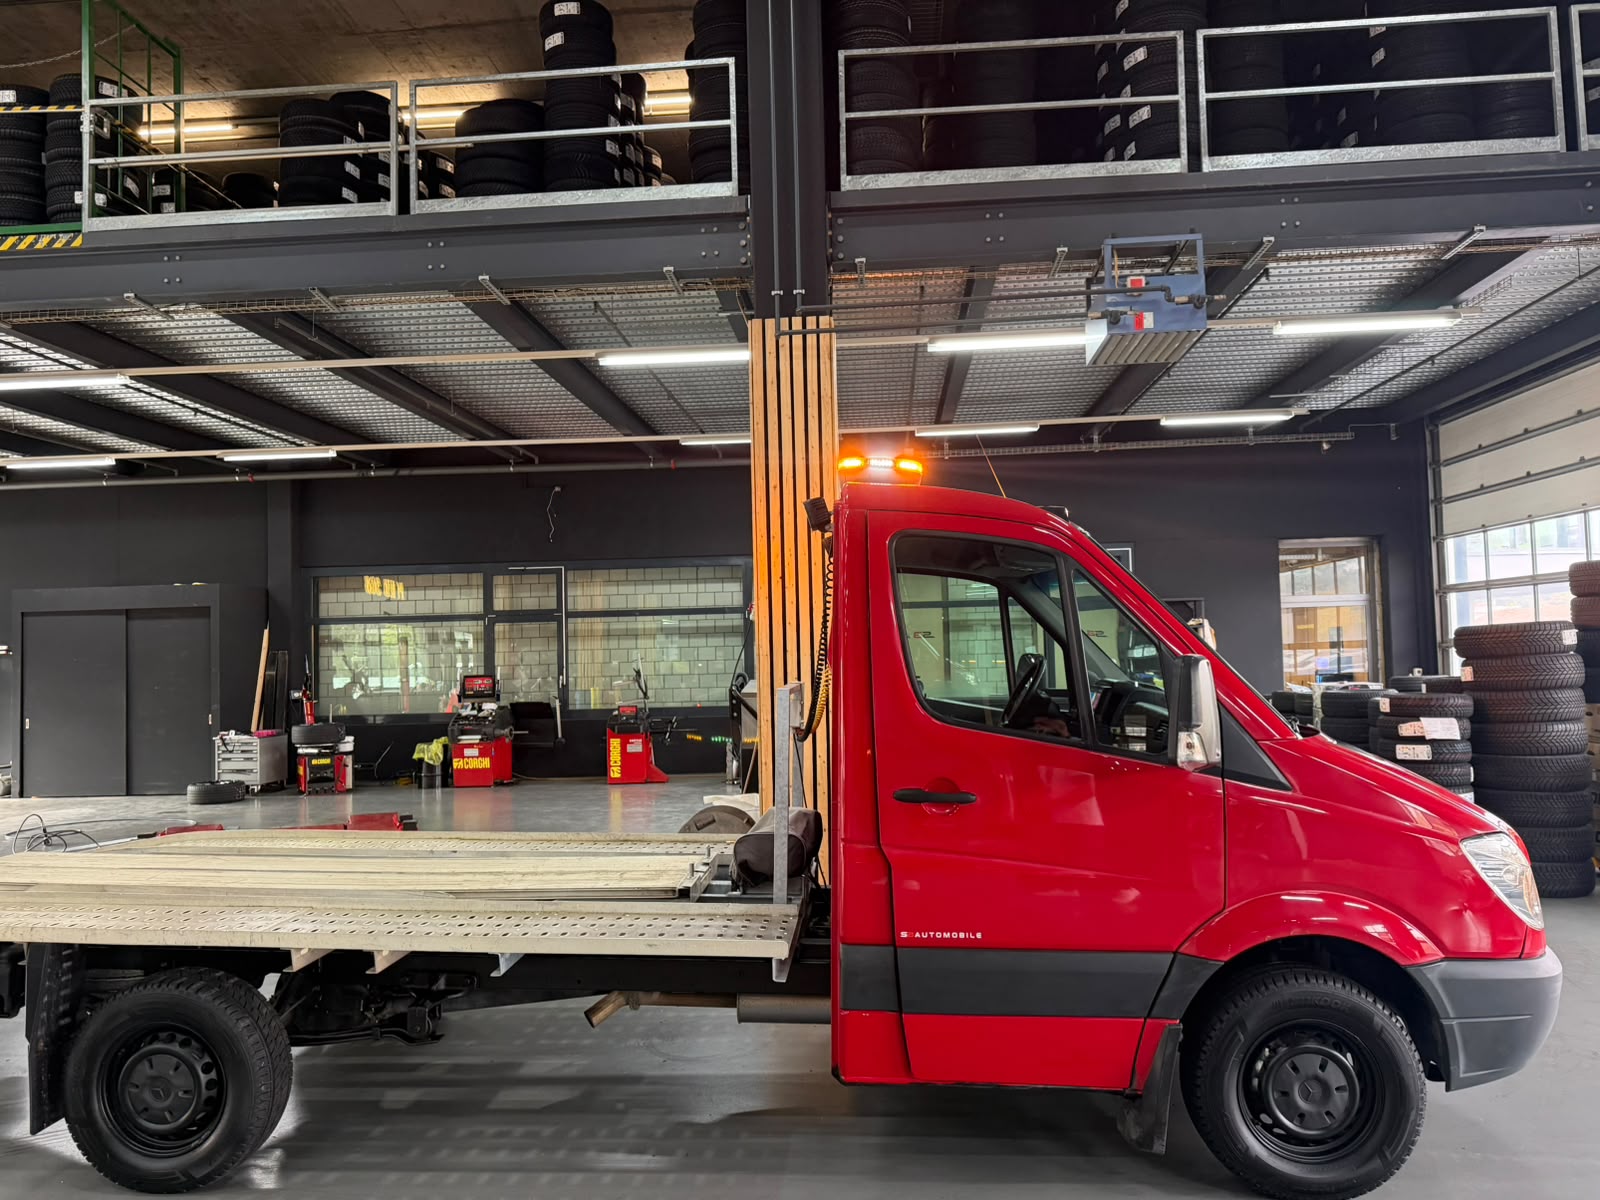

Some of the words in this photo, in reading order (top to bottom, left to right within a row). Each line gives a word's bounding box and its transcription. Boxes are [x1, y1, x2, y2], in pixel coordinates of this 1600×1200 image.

[610, 738, 622, 766] CORGHI
[463, 757, 491, 769] CORGHI
[914, 931, 983, 939] AUTOMOBILE
